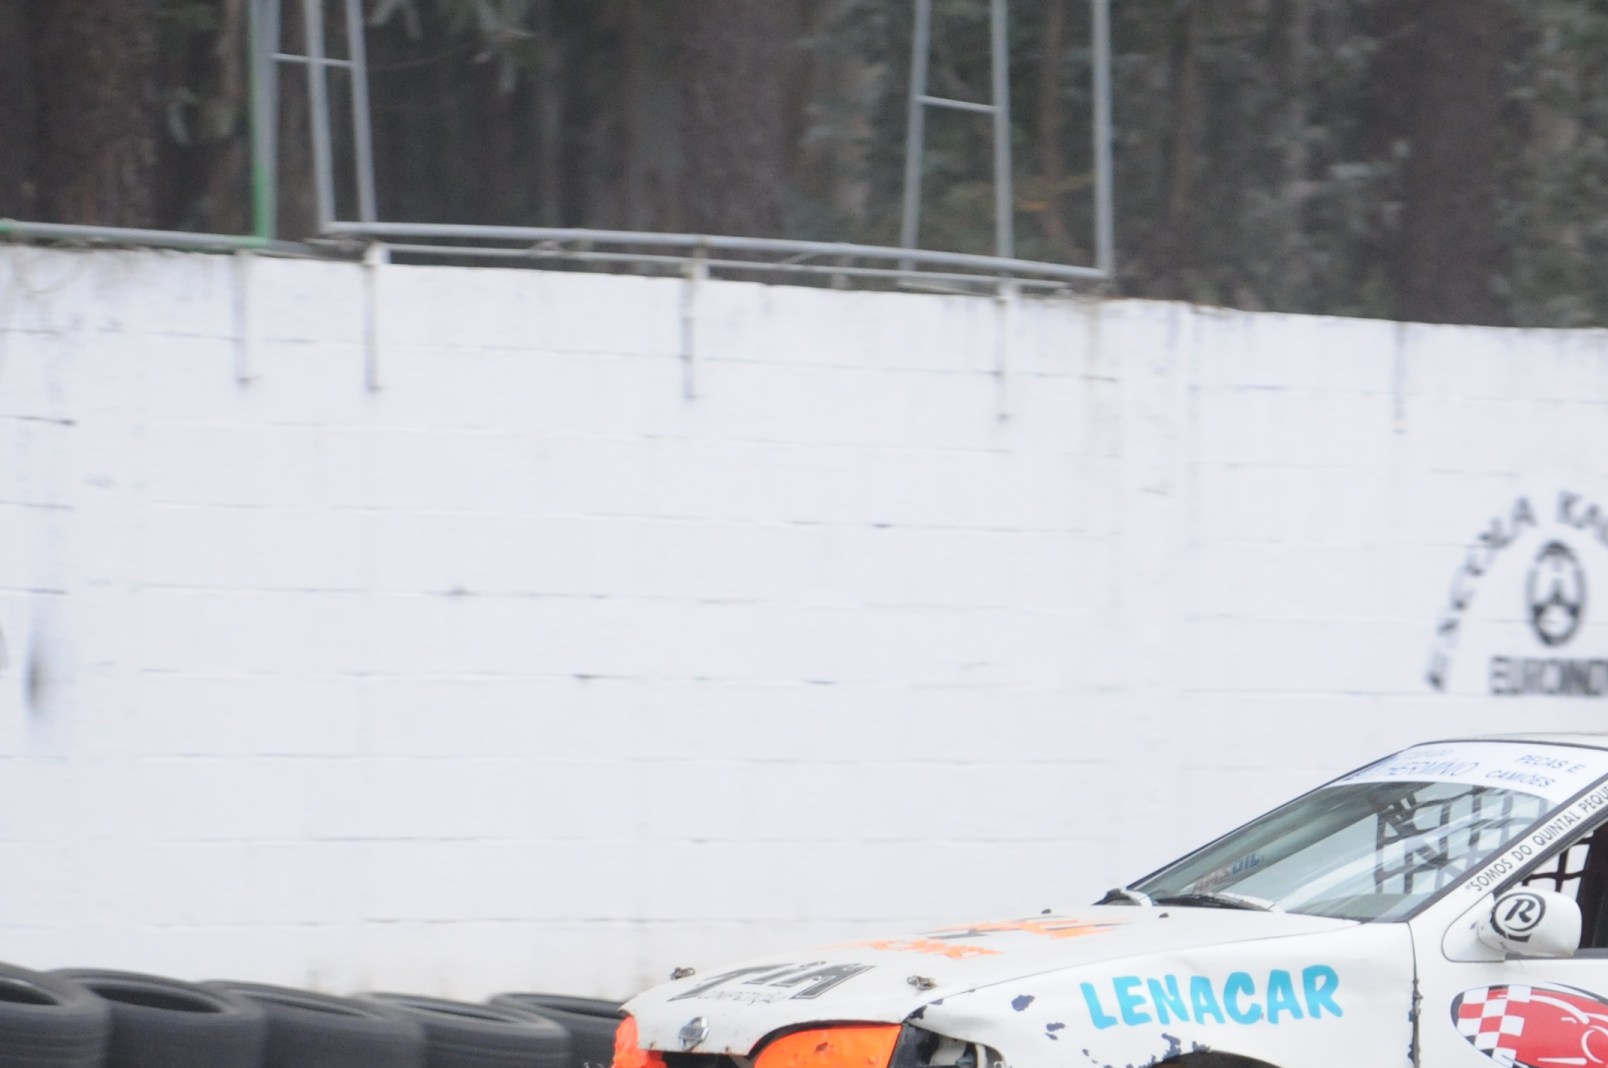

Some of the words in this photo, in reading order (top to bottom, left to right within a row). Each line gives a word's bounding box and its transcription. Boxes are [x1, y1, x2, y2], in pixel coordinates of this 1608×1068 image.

[1511, 844, 1533, 862] DO
[1532, 812, 1582, 847] QUINTAL
[1079, 964, 1344, 1030] LENACAR
